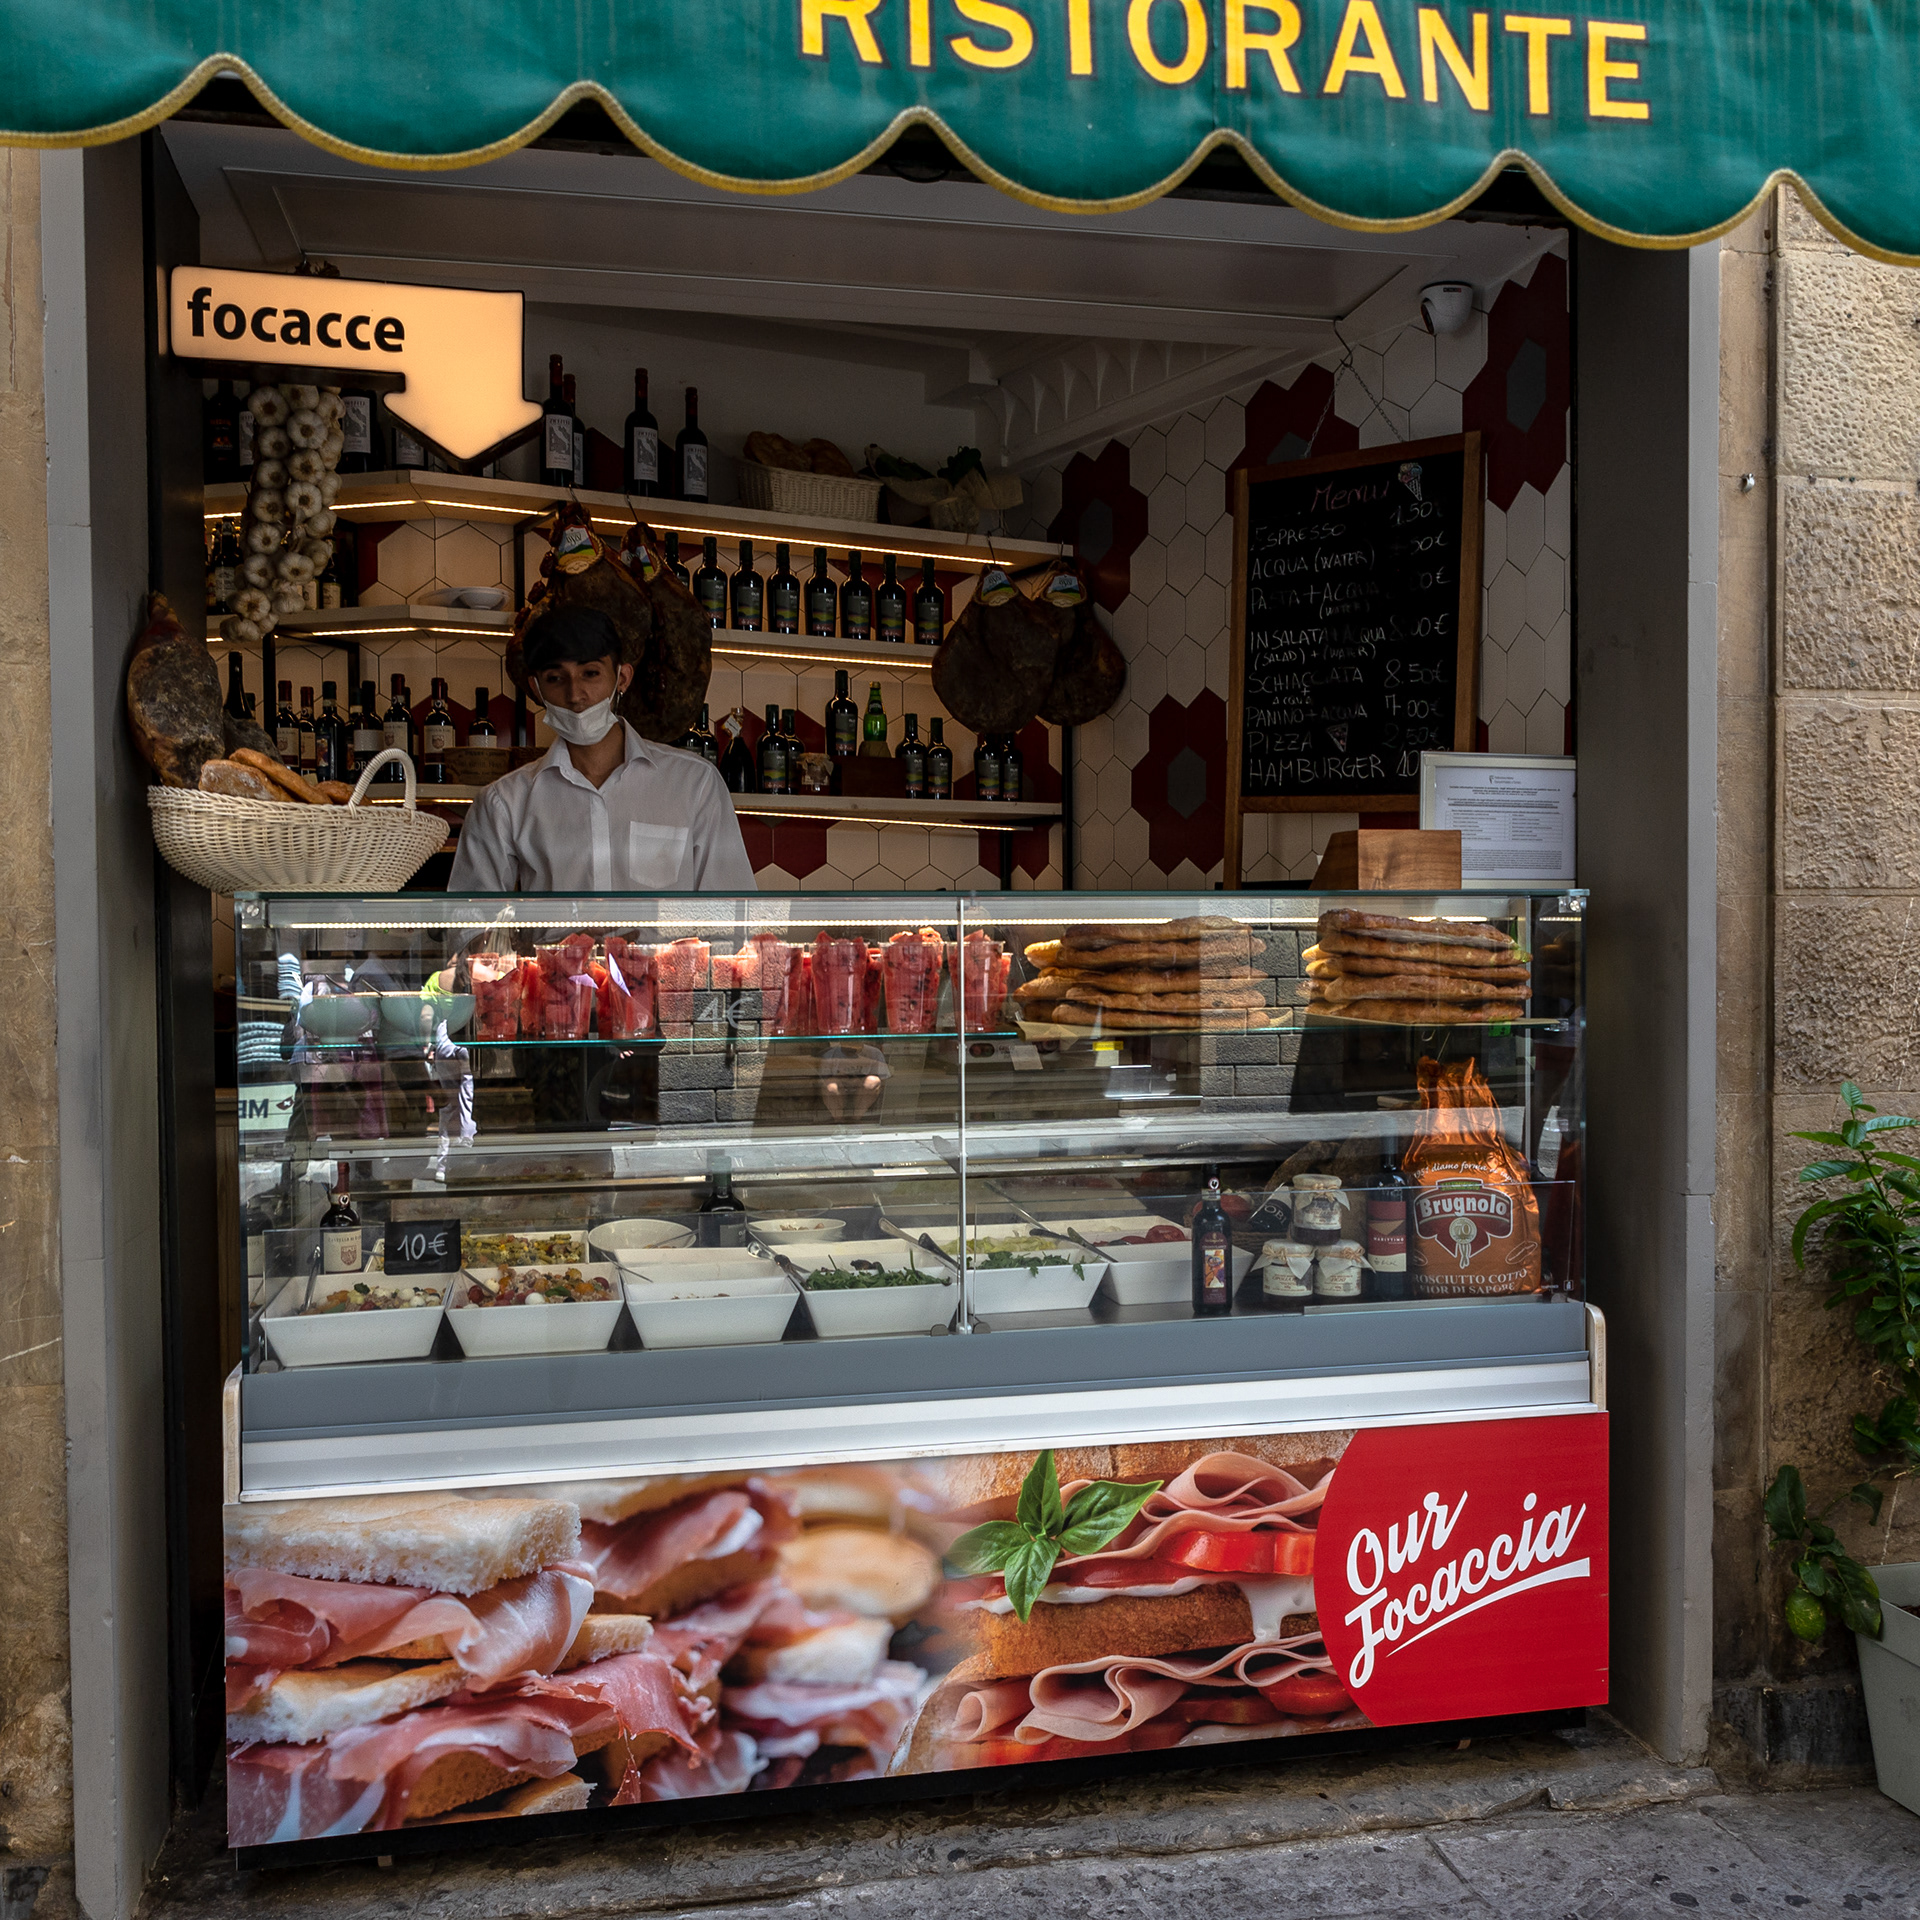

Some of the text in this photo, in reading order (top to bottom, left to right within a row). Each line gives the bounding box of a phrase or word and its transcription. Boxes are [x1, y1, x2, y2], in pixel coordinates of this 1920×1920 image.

[801, 0, 1651, 119] RISTORANTE
[187, 286, 406, 353] focacce
[1250, 523, 1346, 551] ESPRESSO
[1251, 557, 1309, 581] ACQUA
[1384, 658, 1449, 689] 8.50€
[1246, 730, 1313, 755] PIZZA
[1248, 753, 1386, 788] HAMBURGER
[696, 997, 755, 1032] 4€
[1431, 1162, 1459, 1172] diamo
[1420, 1194, 1508, 1217] Brugnolo
[1454, 1223, 1471, 1236] 70
[396, 1232, 449, 1261] 10€
[1452, 1285, 1467, 1294] DI
[1468, 1281, 1517, 1295] SAPORE
[1488, 1267, 1528, 1284] COTTO
[1346, 1490, 1468, 1596] Our
[1344, 1492, 1587, 1688] Focaccia
